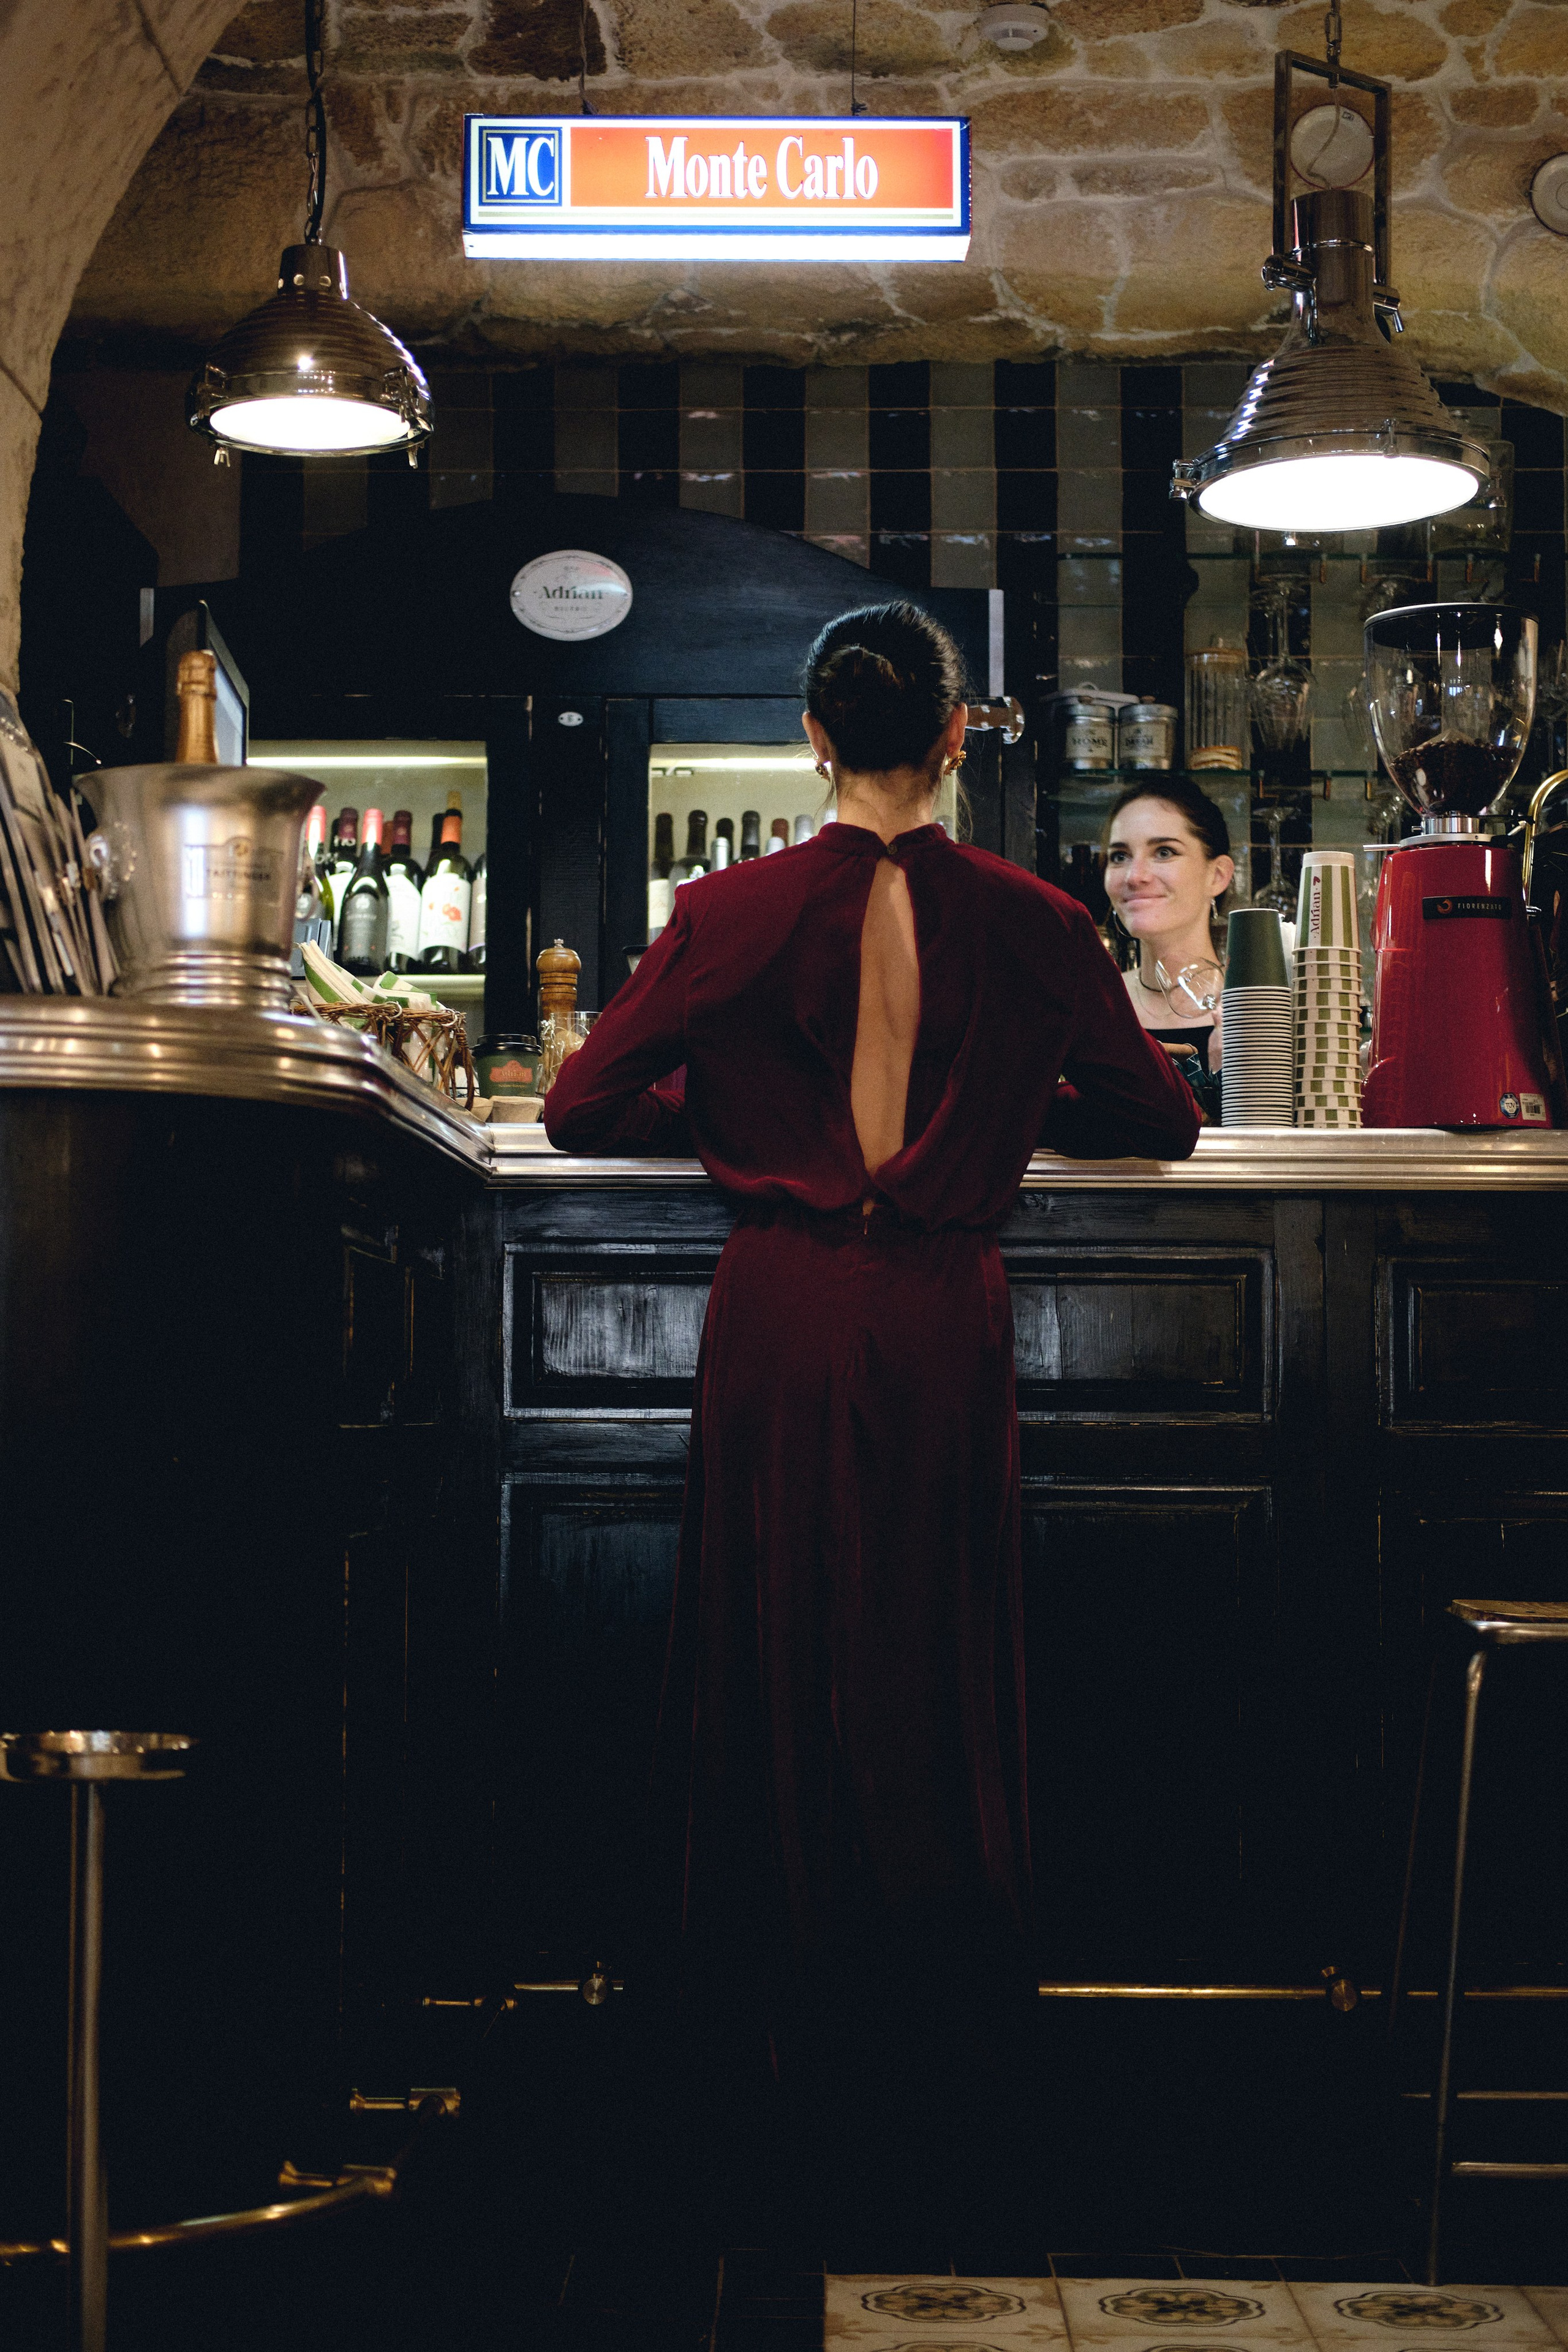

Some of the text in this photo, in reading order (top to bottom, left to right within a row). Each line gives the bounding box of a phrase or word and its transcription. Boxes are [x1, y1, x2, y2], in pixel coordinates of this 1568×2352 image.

[487, 136, 556, 197] MC
[645, 135, 879, 200] Monte Carlo
[1310, 892, 1321, 934] Adrian
